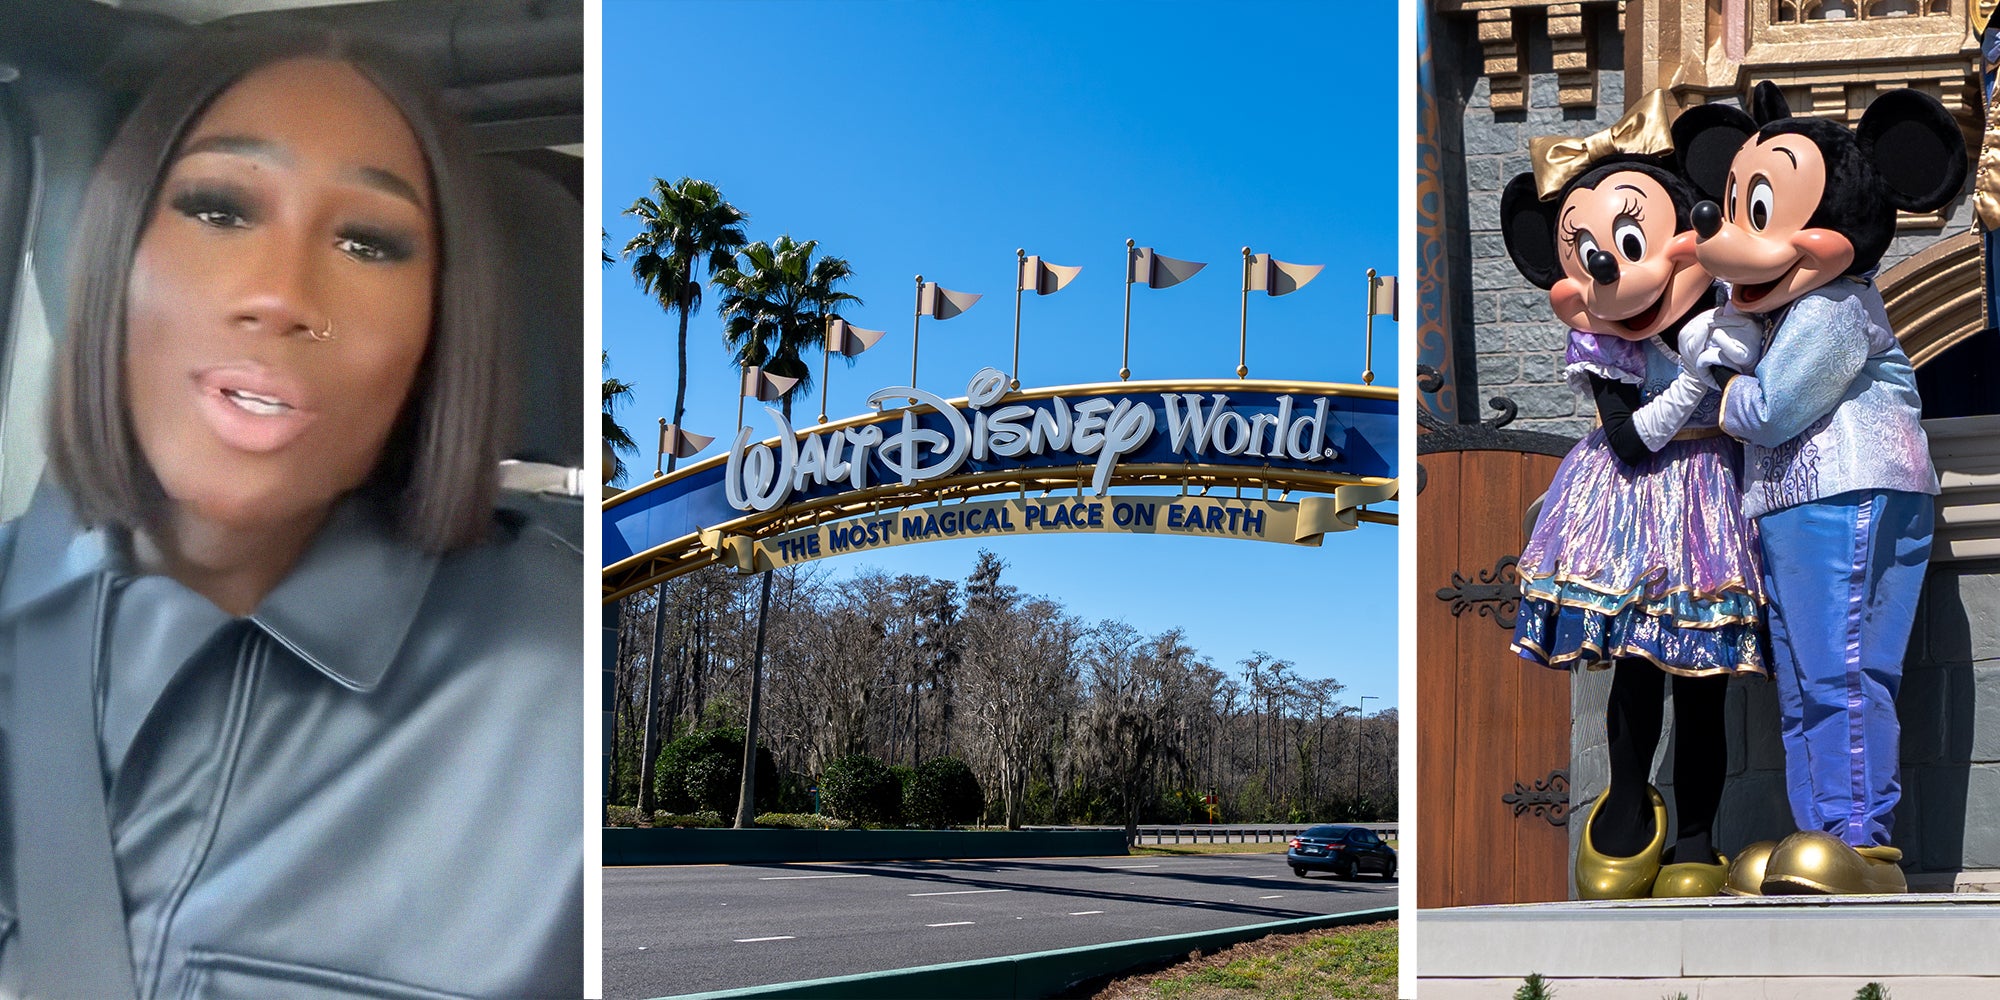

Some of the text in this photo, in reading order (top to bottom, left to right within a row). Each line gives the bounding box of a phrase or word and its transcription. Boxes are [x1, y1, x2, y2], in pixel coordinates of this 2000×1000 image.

[725, 407, 883, 511] WALT
[777, 502, 1266, 561] THE MOST MAGICAL PLACE ON EARTH
